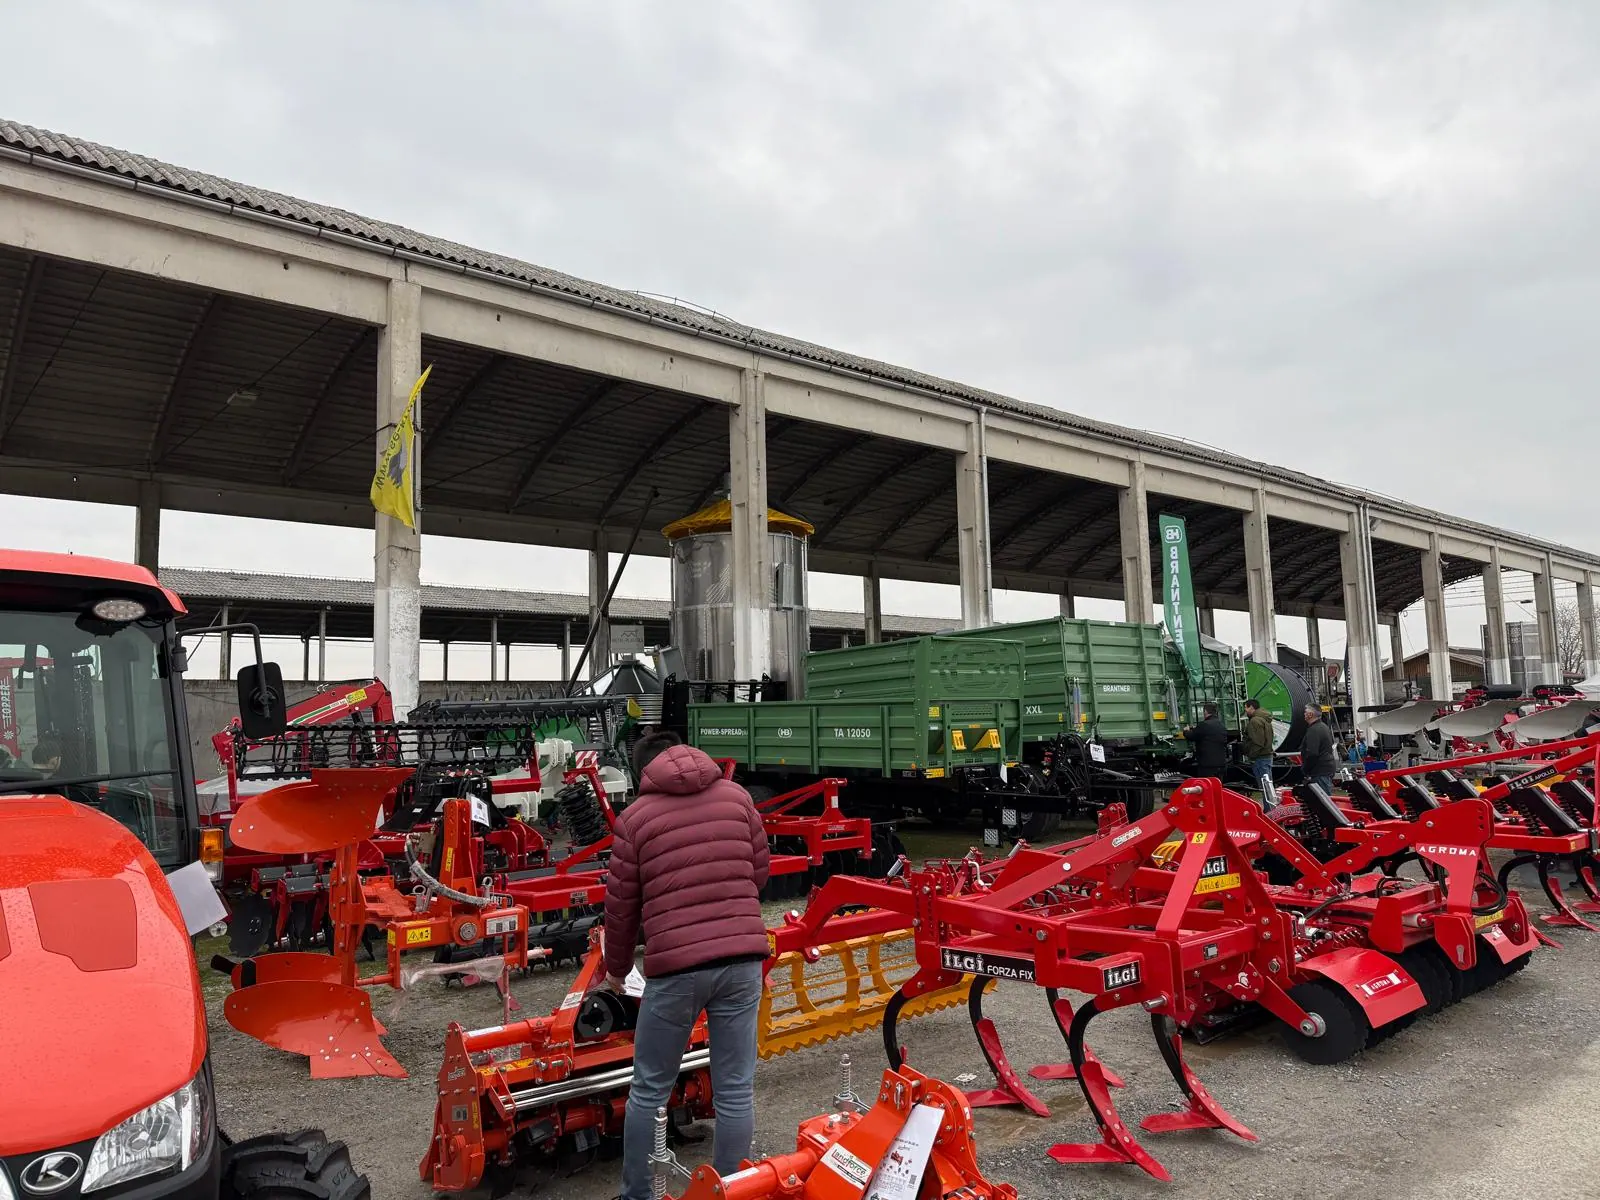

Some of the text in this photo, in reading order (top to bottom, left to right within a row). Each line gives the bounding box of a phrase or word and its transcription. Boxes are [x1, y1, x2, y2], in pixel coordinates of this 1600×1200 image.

[1026, 705, 1042, 714] XXL
[834, 728, 871, 738] TA 12050
[1534, 768, 1556, 781] APOLLO
[1419, 846, 1477, 857] AGROMA
[987, 965, 1018, 979] FORZA
[1019, 969, 1034, 981] FIX
